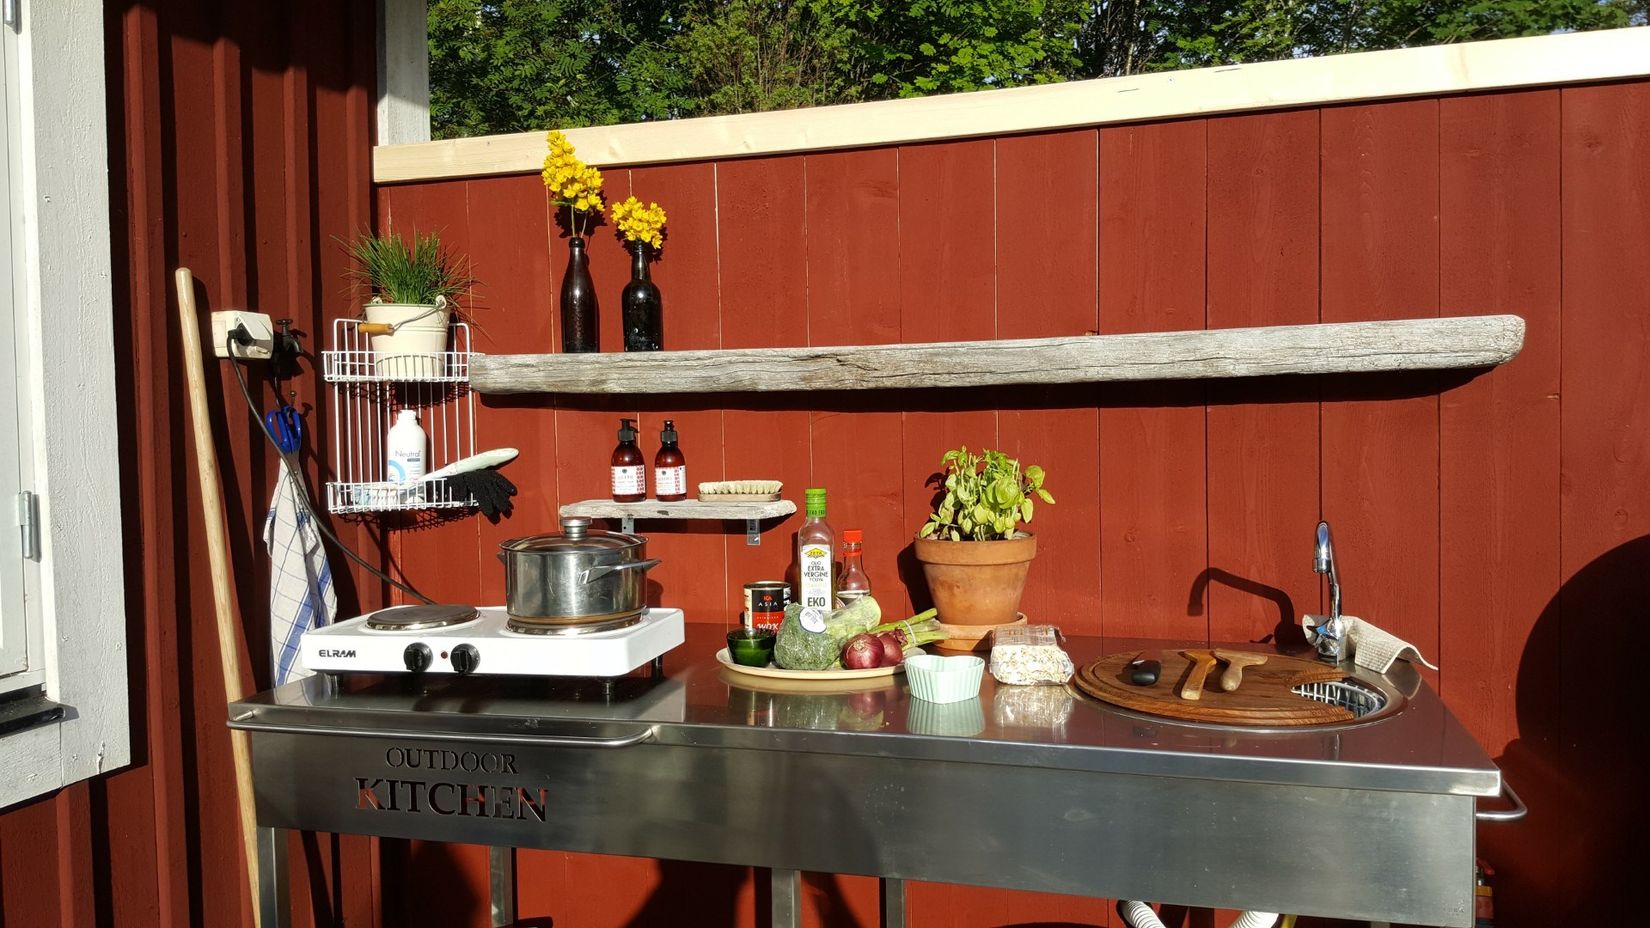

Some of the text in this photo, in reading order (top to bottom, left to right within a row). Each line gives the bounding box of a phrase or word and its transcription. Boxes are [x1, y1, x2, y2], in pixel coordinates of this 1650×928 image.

[807, 597, 826, 607] EKO
[318, 649, 356, 658] ELRAM
[386, 747, 519, 775] OUTDOOR
[355, 777, 549, 823] KITCHEN
